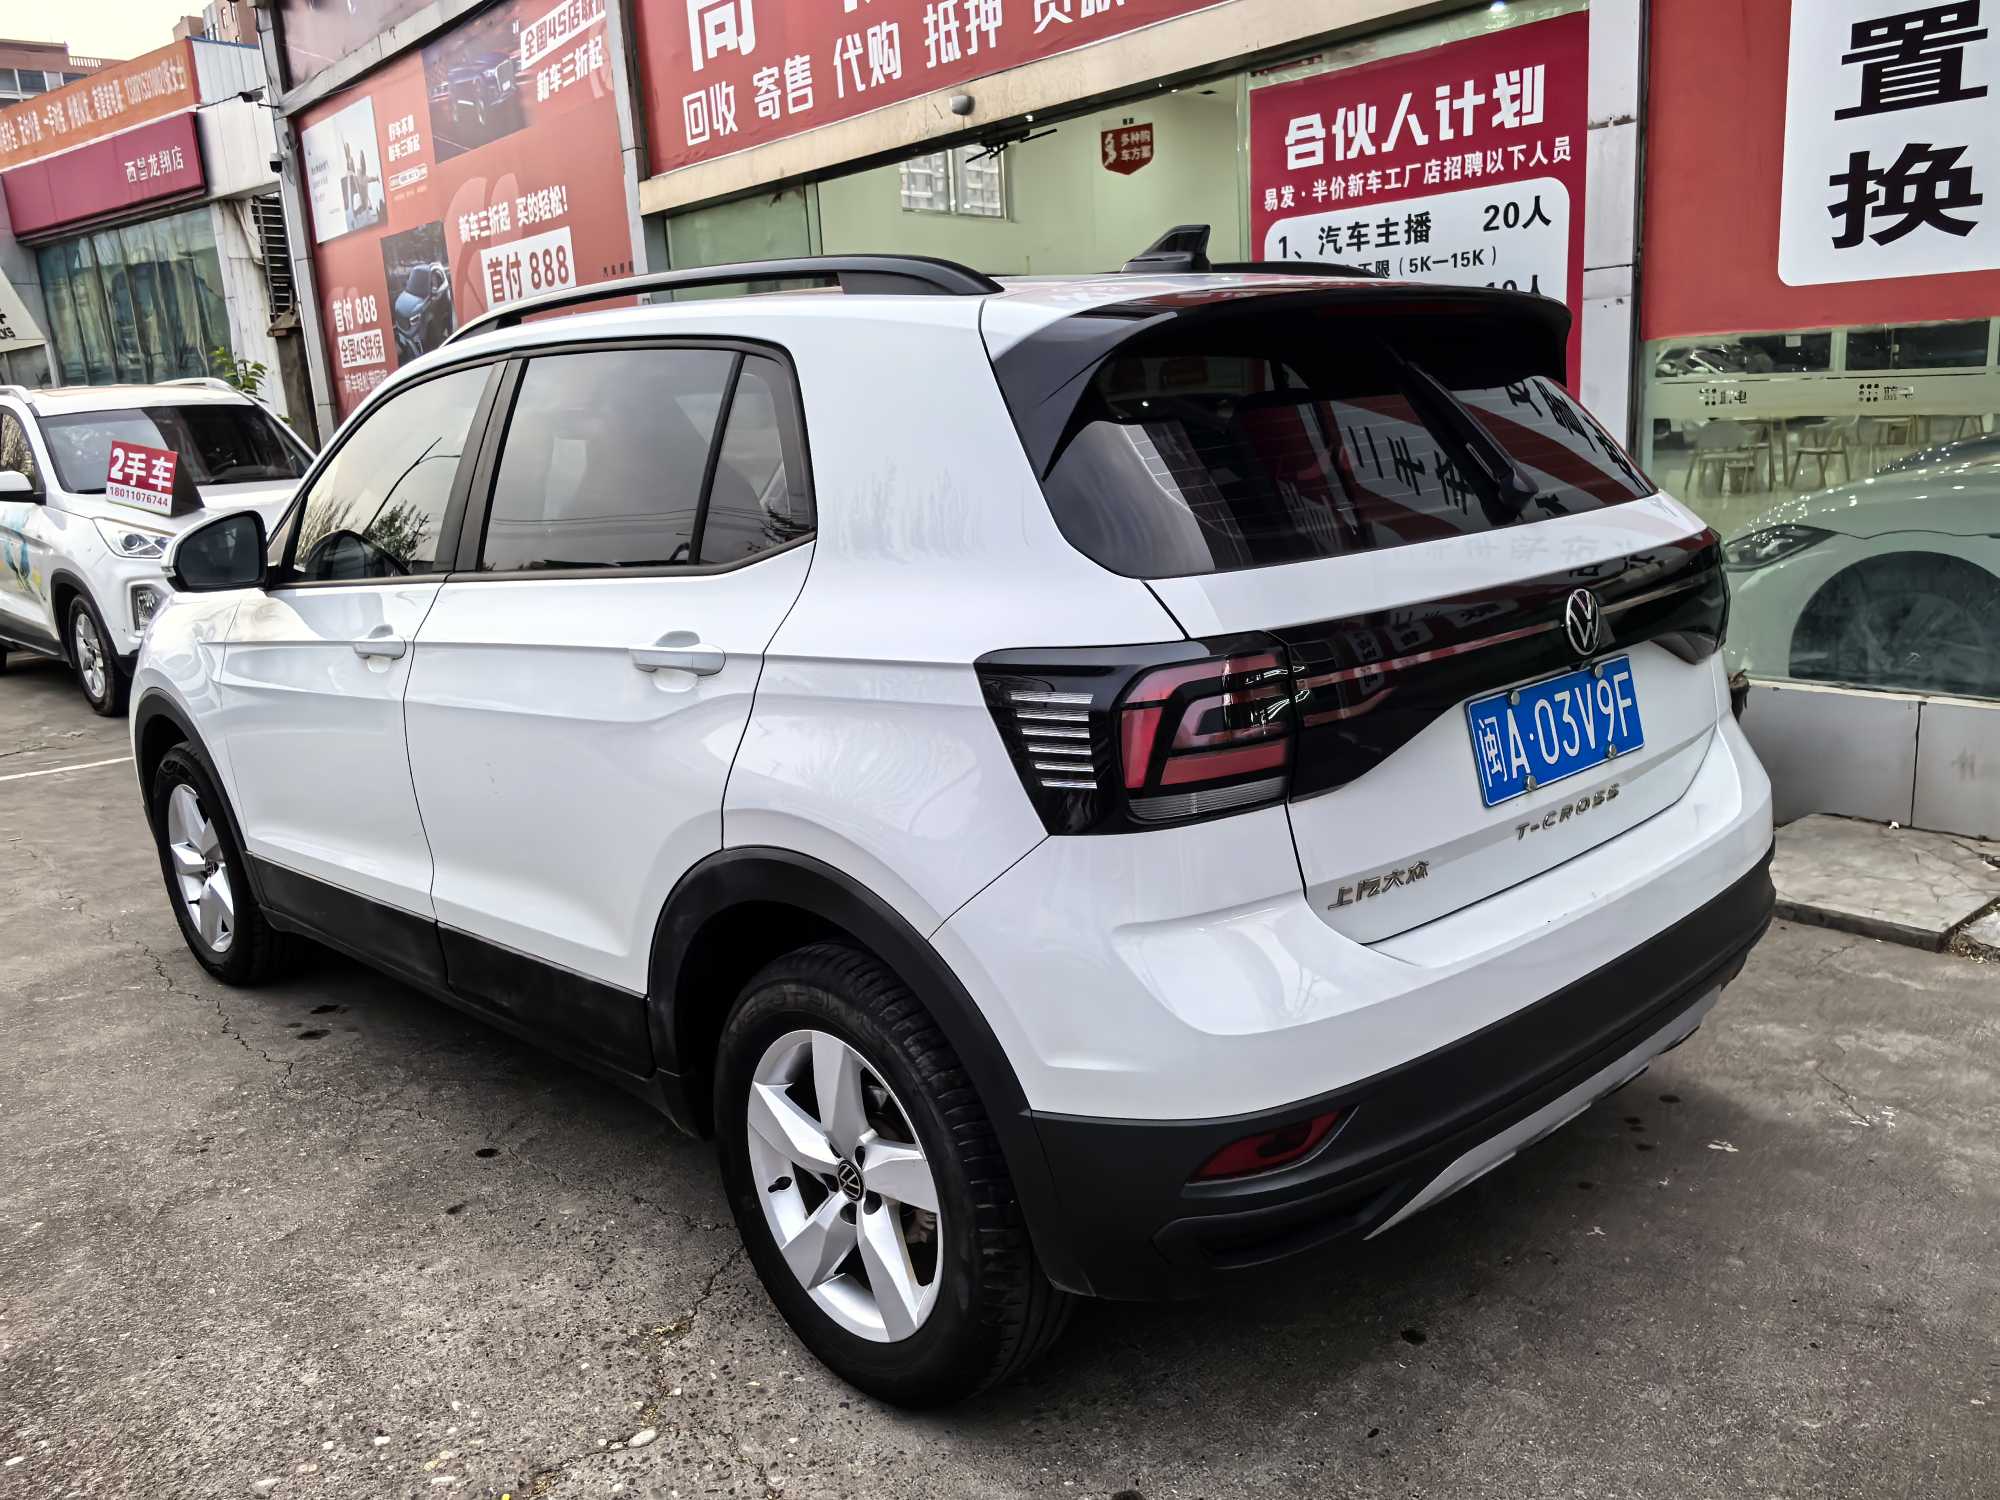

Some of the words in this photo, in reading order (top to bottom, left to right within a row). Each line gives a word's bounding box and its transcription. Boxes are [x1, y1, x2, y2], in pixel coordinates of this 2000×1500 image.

[537, 35, 604, 102] 新车三折起
[683, 80, 739, 147] 回收
[752, 54, 814, 120] 寄售
[833, 20, 903, 99] 代购
[923, 0, 1003, 68] 抵押
[1285, 64, 1546, 171] 合伙人计划
[1827, 0, 1989, 249] 置换
[1264, 136, 1572, 212] 易发·半价新车工厂店招聘以下人员
[459, 201, 511, 242] 新车三折起
[1483, 195, 1553, 232] 20人
[488, 251, 523, 304] 首付
[529, 245, 570, 290] 888
[333, 297, 354, 334] 首付
[355, 294, 378, 325] 888
[110, 447, 174, 491] 2手车
[1515, 783, 1620, 841] T-CROSS
[1328, 860, 1429, 910] 上汽大众
